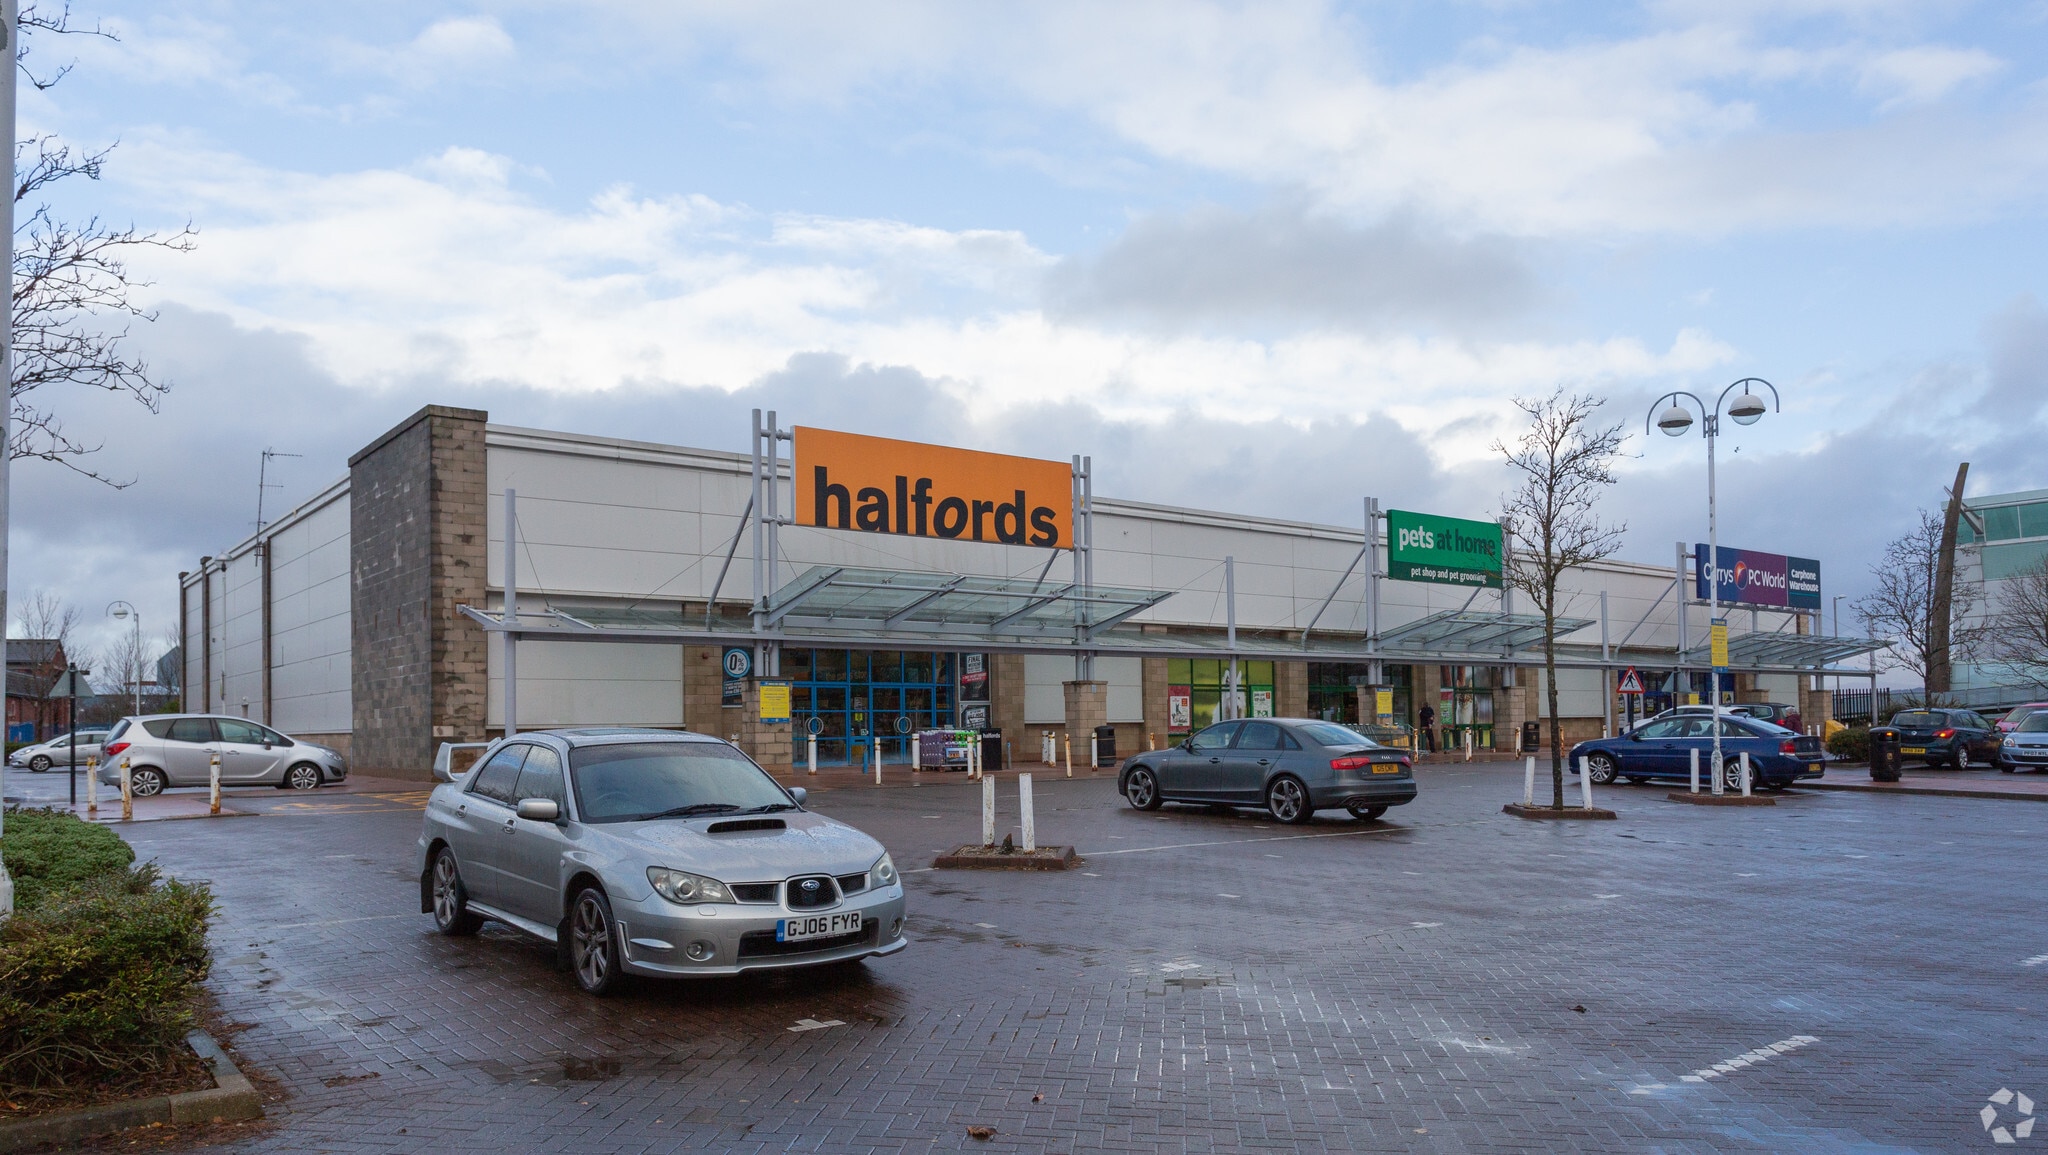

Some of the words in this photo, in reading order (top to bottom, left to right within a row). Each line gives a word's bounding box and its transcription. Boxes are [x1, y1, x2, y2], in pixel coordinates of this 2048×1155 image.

[814, 465, 1059, 548] halfords
[1399, 525, 1434, 551] pets
[1437, 529, 1452, 551] at
[1456, 528, 1496, 556] home
[1411, 567, 1421, 578] pet
[1422, 567, 1436, 580] shop
[1437, 569, 1448, 579] and
[1449, 570, 1459, 580] pet
[1460, 572, 1487, 584] grooming
[1703, 562, 1734, 586] Crrys
[1748, 569, 1761, 586] PC
[1761, 572, 1786, 589] World
[1789, 580, 1819, 592] Warehouse
[1791, 569, 1817, 581] Carphone
[787, 917, 828, 937] GJ06
[831, 912, 860, 931] FYR
